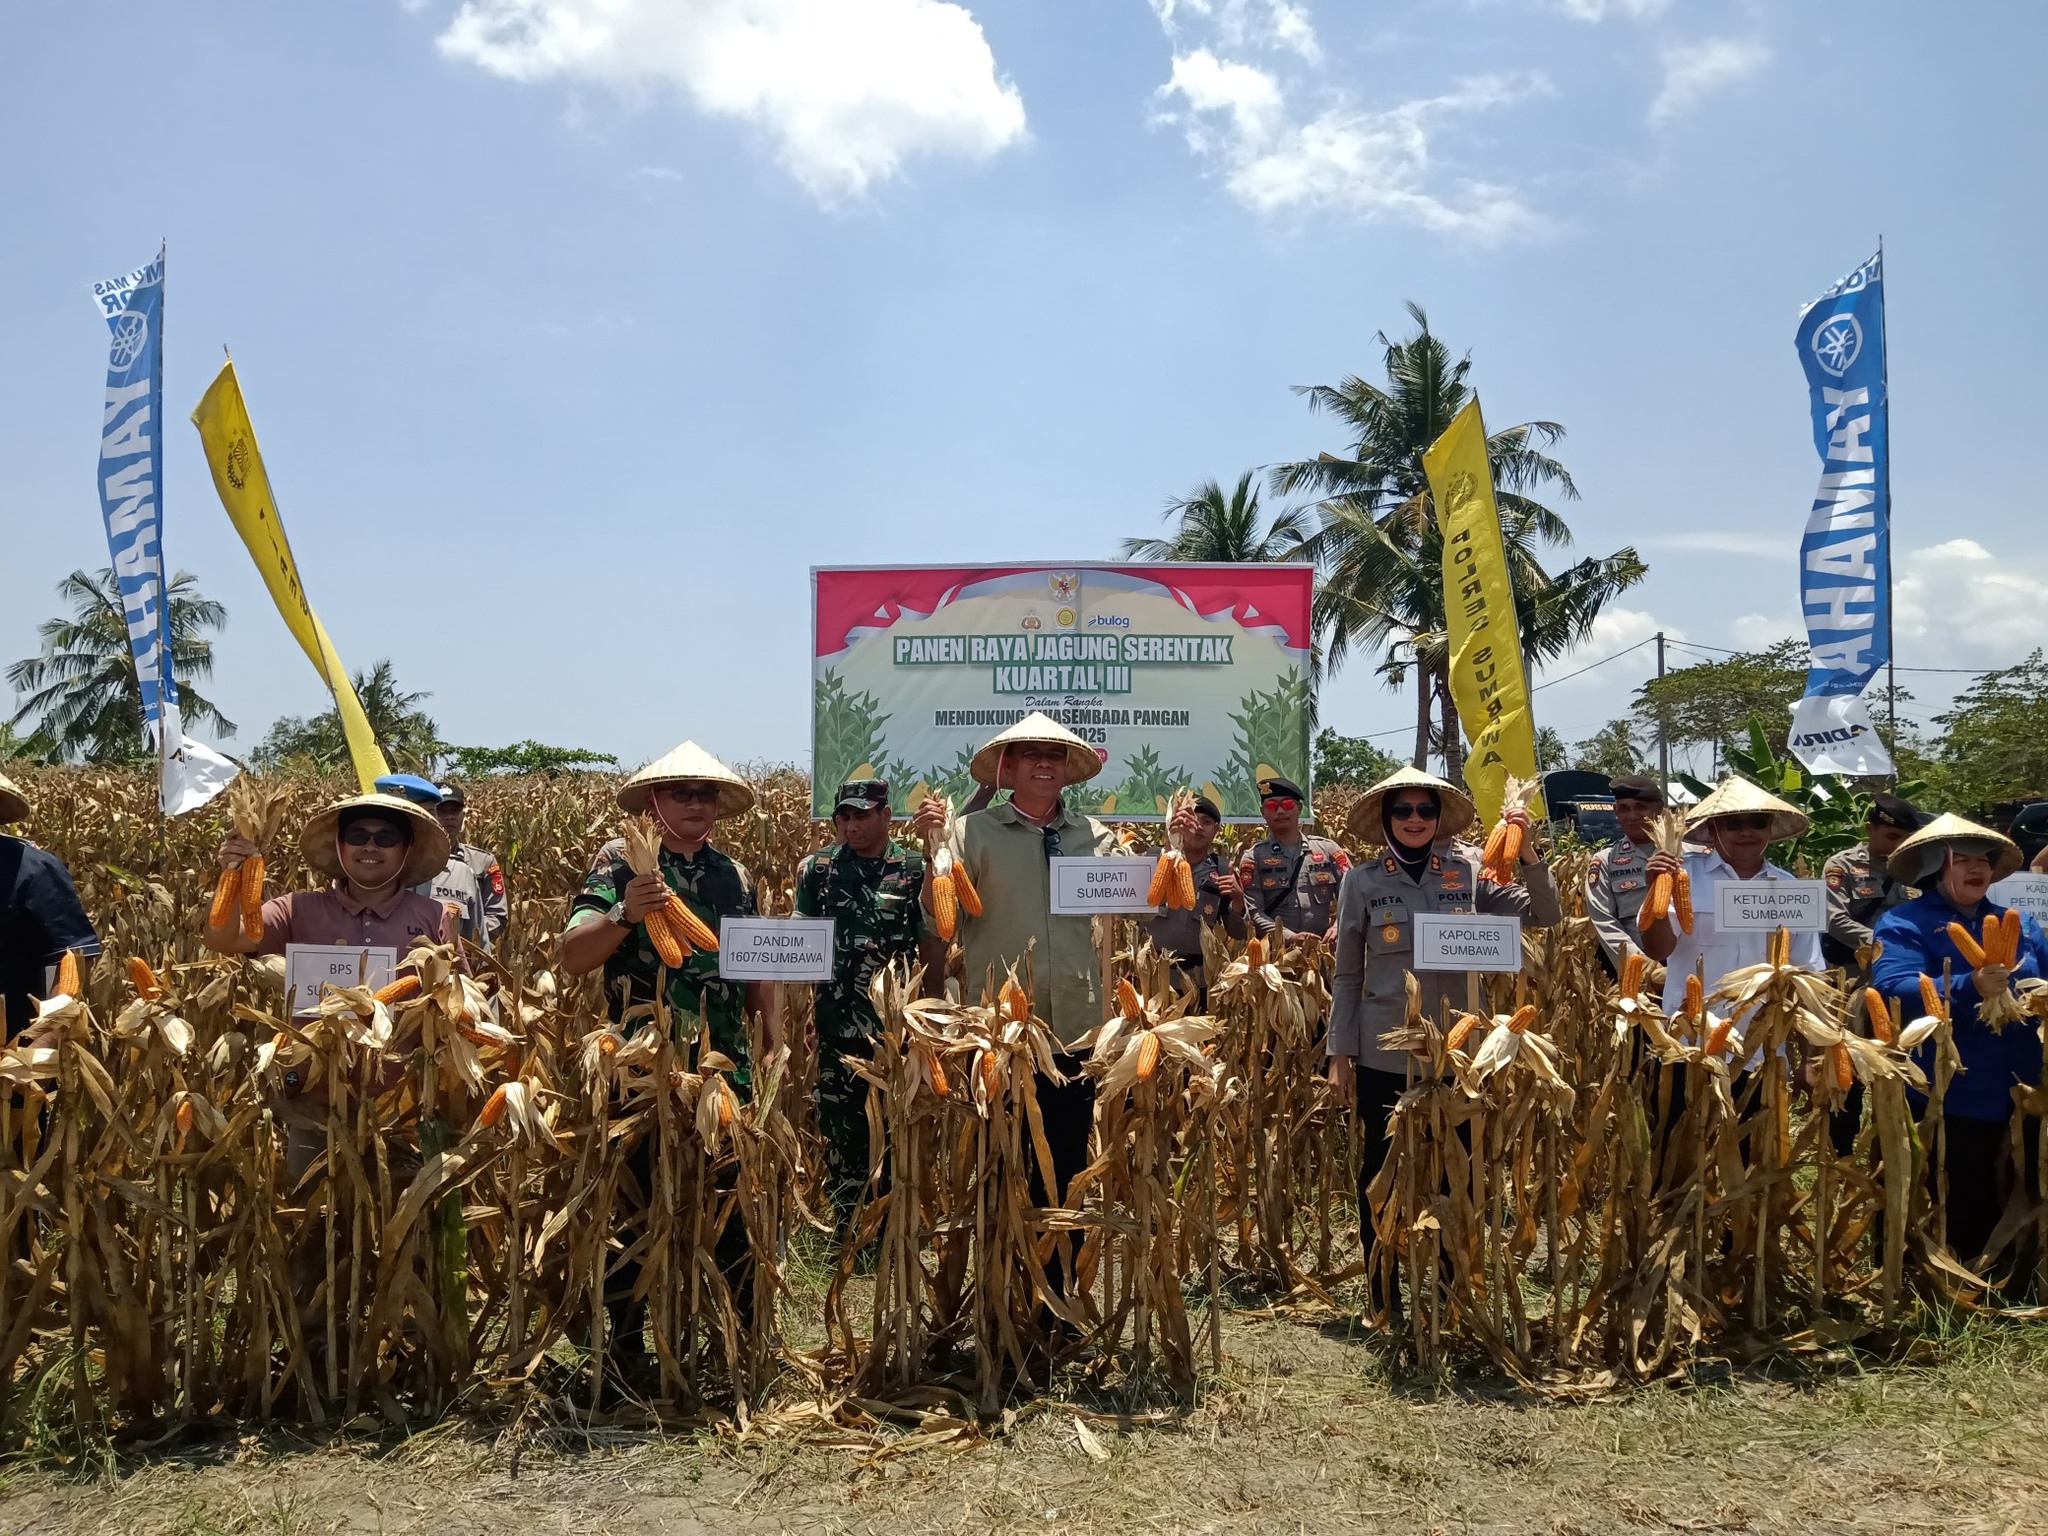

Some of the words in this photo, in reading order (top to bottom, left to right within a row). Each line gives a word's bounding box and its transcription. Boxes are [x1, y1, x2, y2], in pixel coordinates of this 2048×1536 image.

[1097, 615, 1130, 628] bulog
[896, 637, 965, 663] PANEN
[971, 637, 1028, 662] RAYA
[1034, 636, 1117, 662] JAGUNG
[1123, 637, 1231, 662] SERENTAK
[996, 666, 1099, 692] KUARTAL
[1106, 666, 1129, 691] III
[1025, 696, 1060, 707] Dalam
[1063, 695, 1104, 709] Rangka
[1029, 709, 1130, 725] ASEMBADA
[1133, 711, 1190, 727] PANGAN
[1087, 872, 1128, 883] BUPATI
[436, 887, 466, 900] POLRI
[1077, 888, 1137, 898] SUMBAWA
[1371, 896, 1404, 909] RIETA
[1734, 895, 1776, 905] KETUA
[1779, 895, 1811, 905] DPRD
[1742, 910, 1804, 920] SUMBAWA
[1439, 930, 1500, 941] KAPOLRES
[753, 936, 804, 947] DANDIM
[1441, 945, 1500, 956] SUMBAWA
[730, 952, 823, 963] 1607/SUMBAWA
[329, 964, 353, 975] BPS
